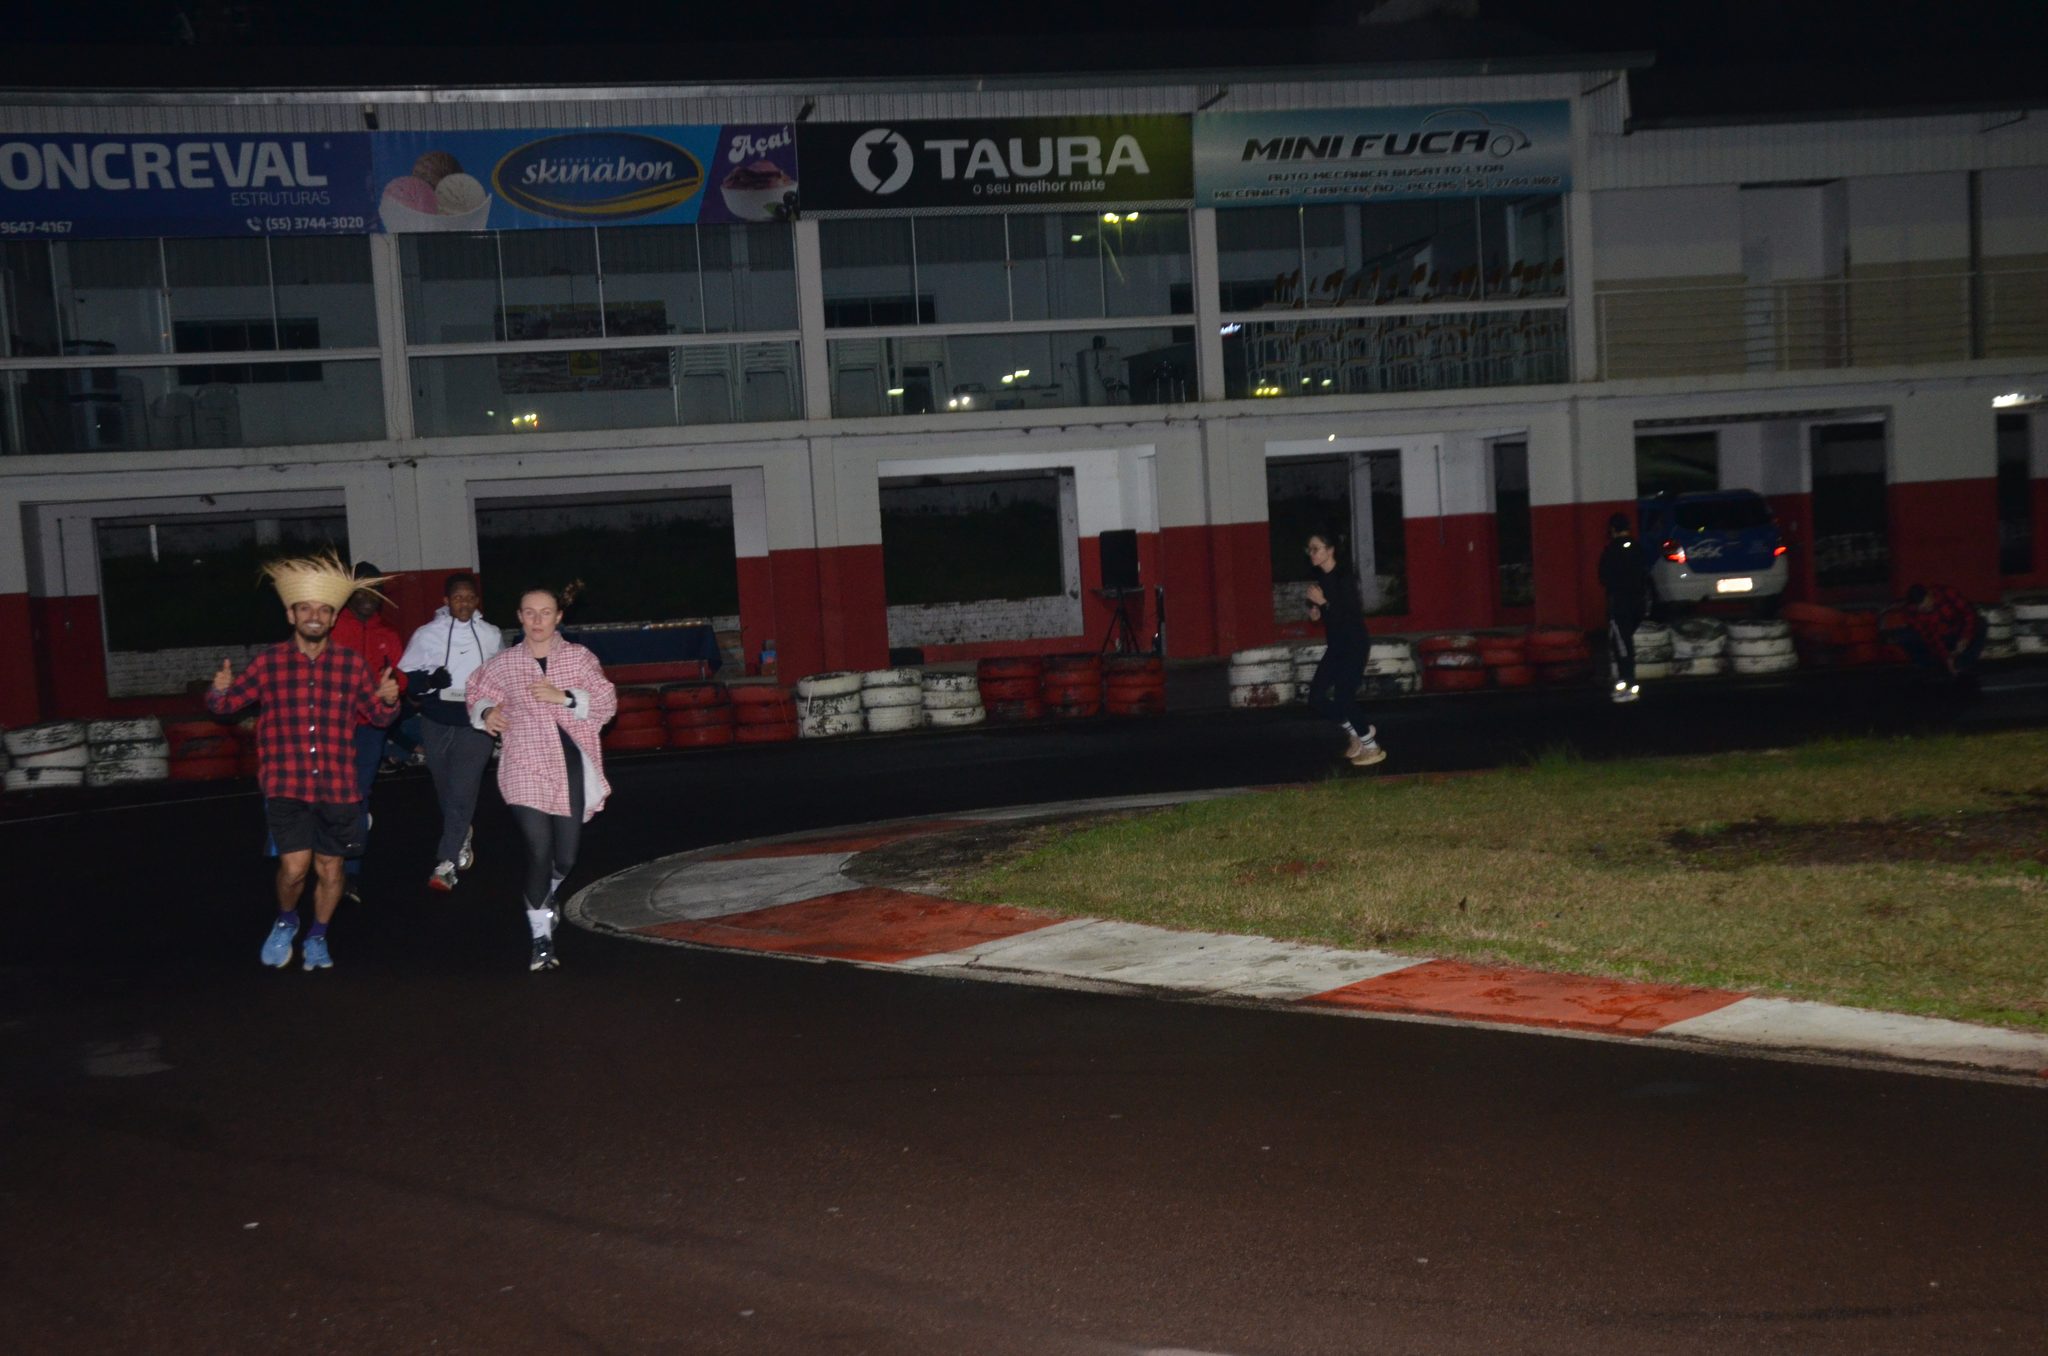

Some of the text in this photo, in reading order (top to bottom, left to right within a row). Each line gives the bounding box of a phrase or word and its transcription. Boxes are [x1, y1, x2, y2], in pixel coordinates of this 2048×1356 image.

[728, 125, 792, 164] Açaí
[924, 134, 1151, 180] TAURA
[1241, 129, 1491, 162] MINI FUCA
[0, 141, 329, 190] ONCREVAL
[521, 156, 677, 186] skinabon
[231, 190, 331, 207] ESTRUTURAS
[972, 179, 1106, 195] o seu melhor mate
[0, 221, 73, 234] 9647-4167
[266, 216, 364, 231] (55) 3744-3020
